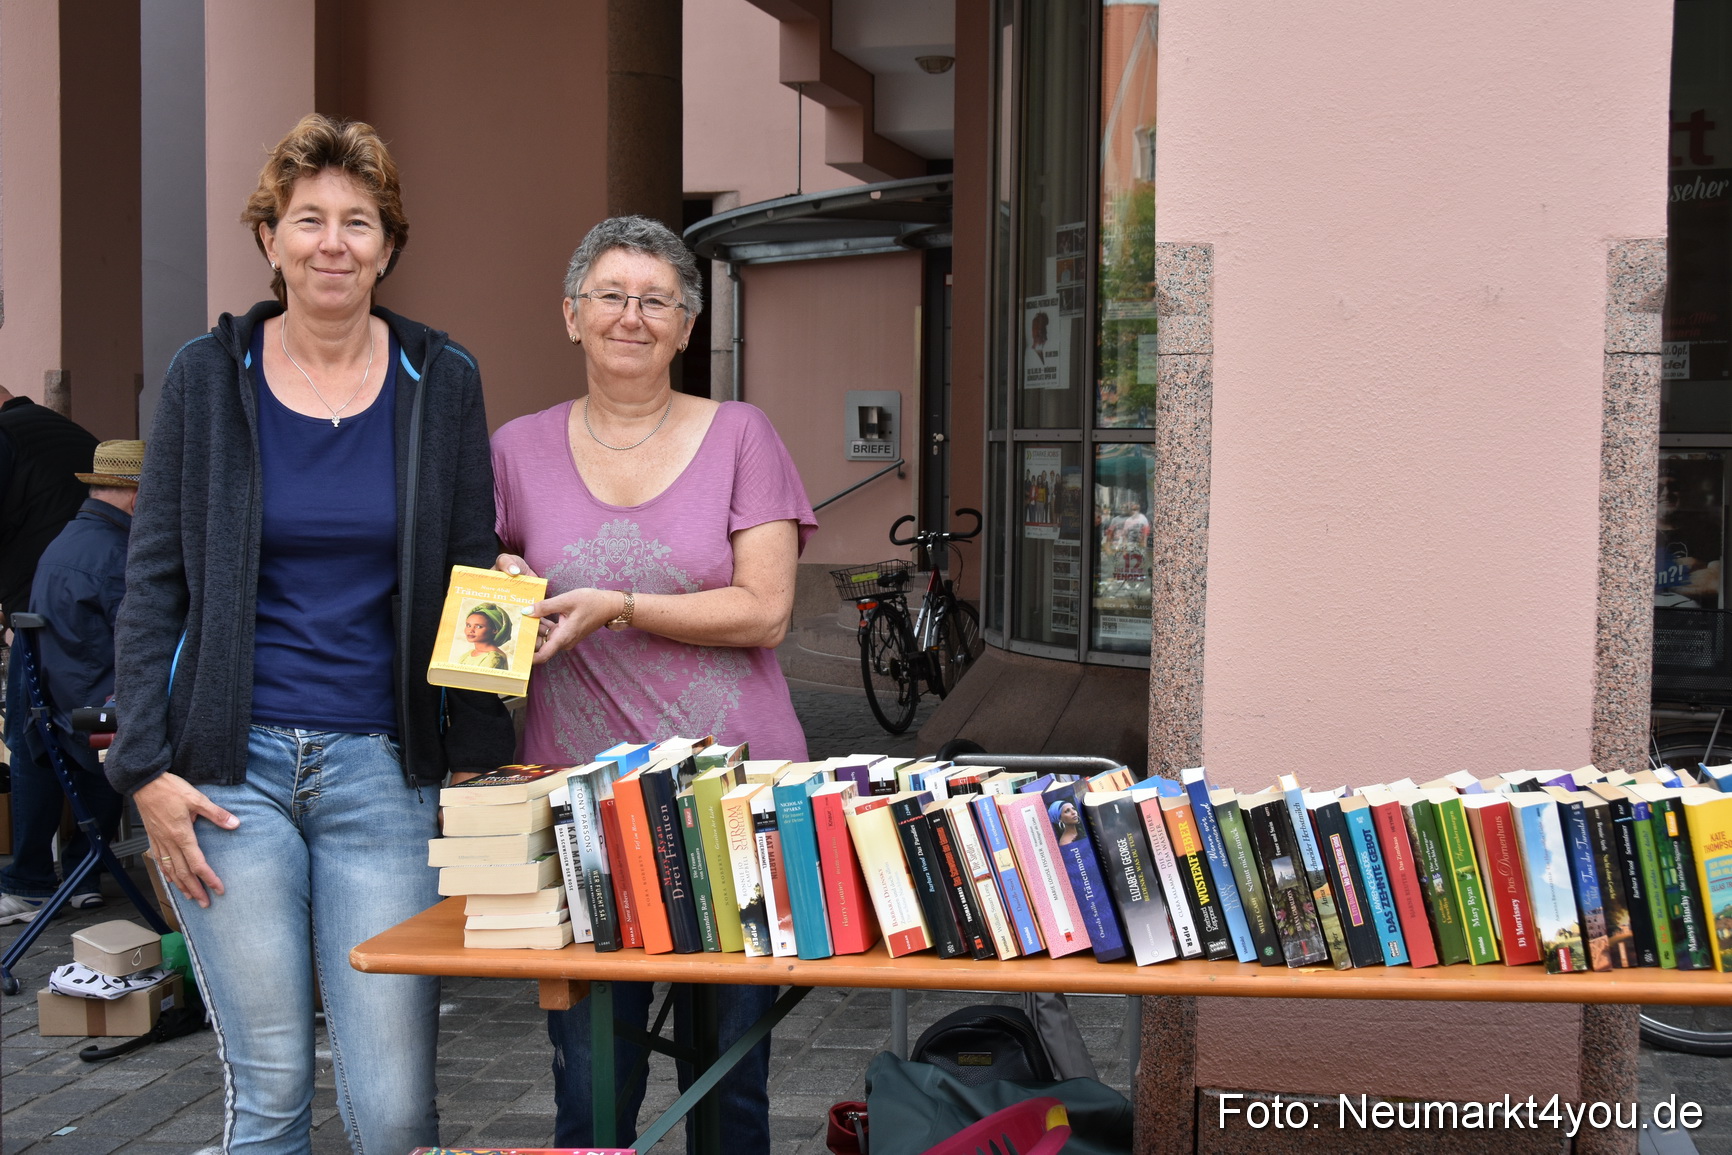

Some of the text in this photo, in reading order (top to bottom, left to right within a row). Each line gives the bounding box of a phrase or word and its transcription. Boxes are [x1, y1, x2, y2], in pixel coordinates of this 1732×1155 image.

[853, 444, 891, 454] BRIEFE
[1123, 553, 1143, 572] 12
[1113, 573, 1145, 582] TENORS
[454, 585, 535, 605] Tränen im Sand
[685, 810, 693, 826] Knaur
[780, 800, 803, 808] NICHOLAS
[577, 787, 592, 853] TONY PARSONS
[727, 806, 743, 851] STROM
[736, 805, 749, 851] SCHNELLEN
[1573, 818, 1589, 849] Tarantel
[1666, 815, 1677, 834] Knaur
[765, 835, 774, 850] KAT
[910, 825, 920, 846] Paradies
[1127, 833, 1135, 848] TUST
[1146, 814, 1167, 870] DIE STILLE ÜBER
[1156, 824, 1173, 868] DEM WASSER
[1200, 803, 1228, 867] zusammen sind
[1201, 817, 1218, 861] Wenn wir
[1230, 827, 1243, 850] zurück
[1393, 836, 1402, 860] Zimthaus
[1422, 831, 1432, 861] verborgene
[1710, 831, 1726, 842] KATE
[561, 839, 569, 867] SCHWEIGEN
[567, 826, 585, 890] KAT MARTIN
[657, 826, 675, 886] Mary Ryan
[659, 805, 684, 900] Drei Frauen
[758, 836, 767, 869] FEUERHIMMEL
[768, 851, 777, 880] MARTIN
[919, 857, 928, 872] Wood
[965, 843, 981, 871] Die Siedler
[1132, 849, 1138, 858] DU
[1238, 851, 1248, 869] nicht
[1331, 836, 1350, 886] Wo hohe Türme sind
[1428, 840, 1439, 871] Geschichte
[1581, 852, 1591, 862] der
[1622, 825, 1640, 899] Barbara Wood Seelenfeuer
[638, 855, 647, 885] ROBERTS
[717, 854, 726, 884] ROBERTS
[738, 862, 748, 897] BONNIE JO
[743, 856, 752, 888] CAMPBELL
[925, 872, 935, 892] Barbara
[1039, 848, 1058, 901] MARIE LOUISE FISCHER
[1071, 848, 1094, 900] Tränenmond
[1117, 838, 1142, 902] ELIZABETH GEORGE
[1244, 869, 1254, 892] Schaut
[1293, 802, 1343, 950] Piper Anna Wimschneider Herbstmilch
[1361, 851, 1383, 914] LAWRENCE SANDERS
[1362, 829, 1397, 934] DAS ZEHNTE GEBOT
[1450, 811, 1481, 927] Mary Ryan Septembermorgen
[1495, 816, 1527, 947] Di Morrissey Das Dornenhaus
[1581, 864, 1595, 883] Tanz
[595, 885, 604, 907] FURCHT
[878, 869, 899, 928] BARBARA DELINSKY
[1139, 872, 1150, 902] BEDENKE,
[1168, 874, 1184, 918] CLARA SALAMAN
[1218, 884, 1232, 912] MARC
[1226, 884, 1240, 909] LEVY
[1608, 881, 1616, 899] Gesicht
[957, 887, 973, 922] THOMAS HARRIS
[988, 897, 997, 913] Stuart
[1251, 897, 1260, 914] CASH
[1287, 889, 1298, 916] GABALDON
[1438, 899, 1447, 924] Caroline
[700, 895, 713, 943] Alexandra Raife
[994, 913, 1003, 933] William
[1096, 918, 1105, 938] Ouarda
[1200, 906, 1214, 933] Gerhard
[1206, 906, 1219, 931] Keppner
[1257, 915, 1266, 934] WILEY
[1294, 916, 1302, 932] DIANA
[1681, 895, 1697, 952] Maeve Binchy
[750, 925, 759, 946] PIPER
[1001, 936, 1010, 953] Weltbild
[1182, 926, 1193, 947] PIPER
[1559, 949, 1568, 970] GOLDMANN
